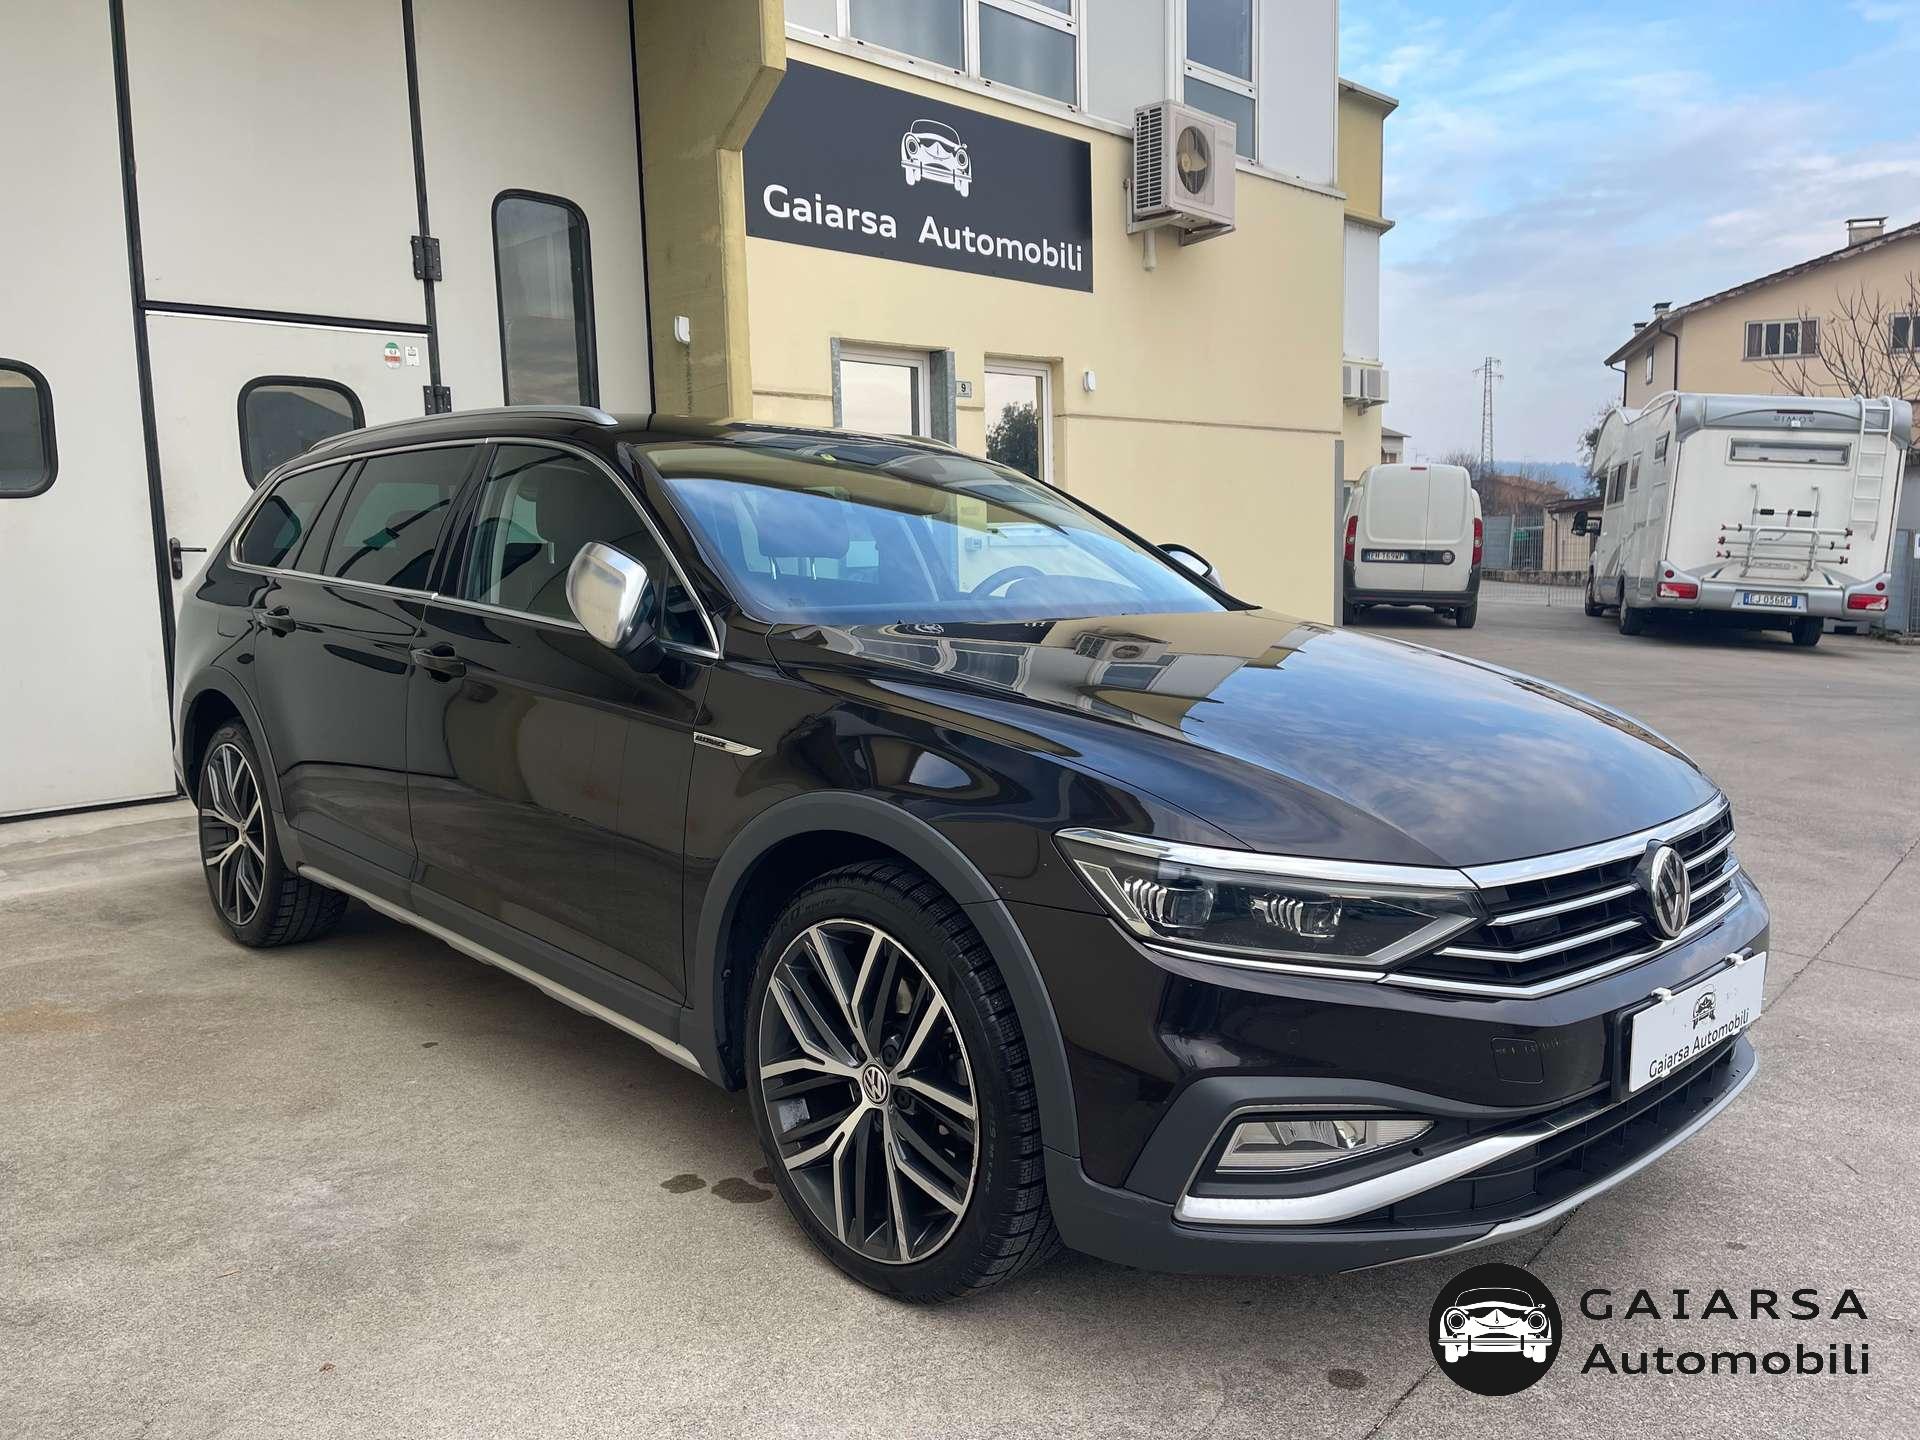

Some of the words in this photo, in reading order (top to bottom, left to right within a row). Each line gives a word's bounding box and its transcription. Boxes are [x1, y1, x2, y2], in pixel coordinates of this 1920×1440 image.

[762, 184, 897, 239] Gaiarsa
[918, 215, 1083, 272] Automobili
[1649, 1045, 1690, 1079] Gaiarsa
[1691, 1007, 1750, 1055] Automobili
